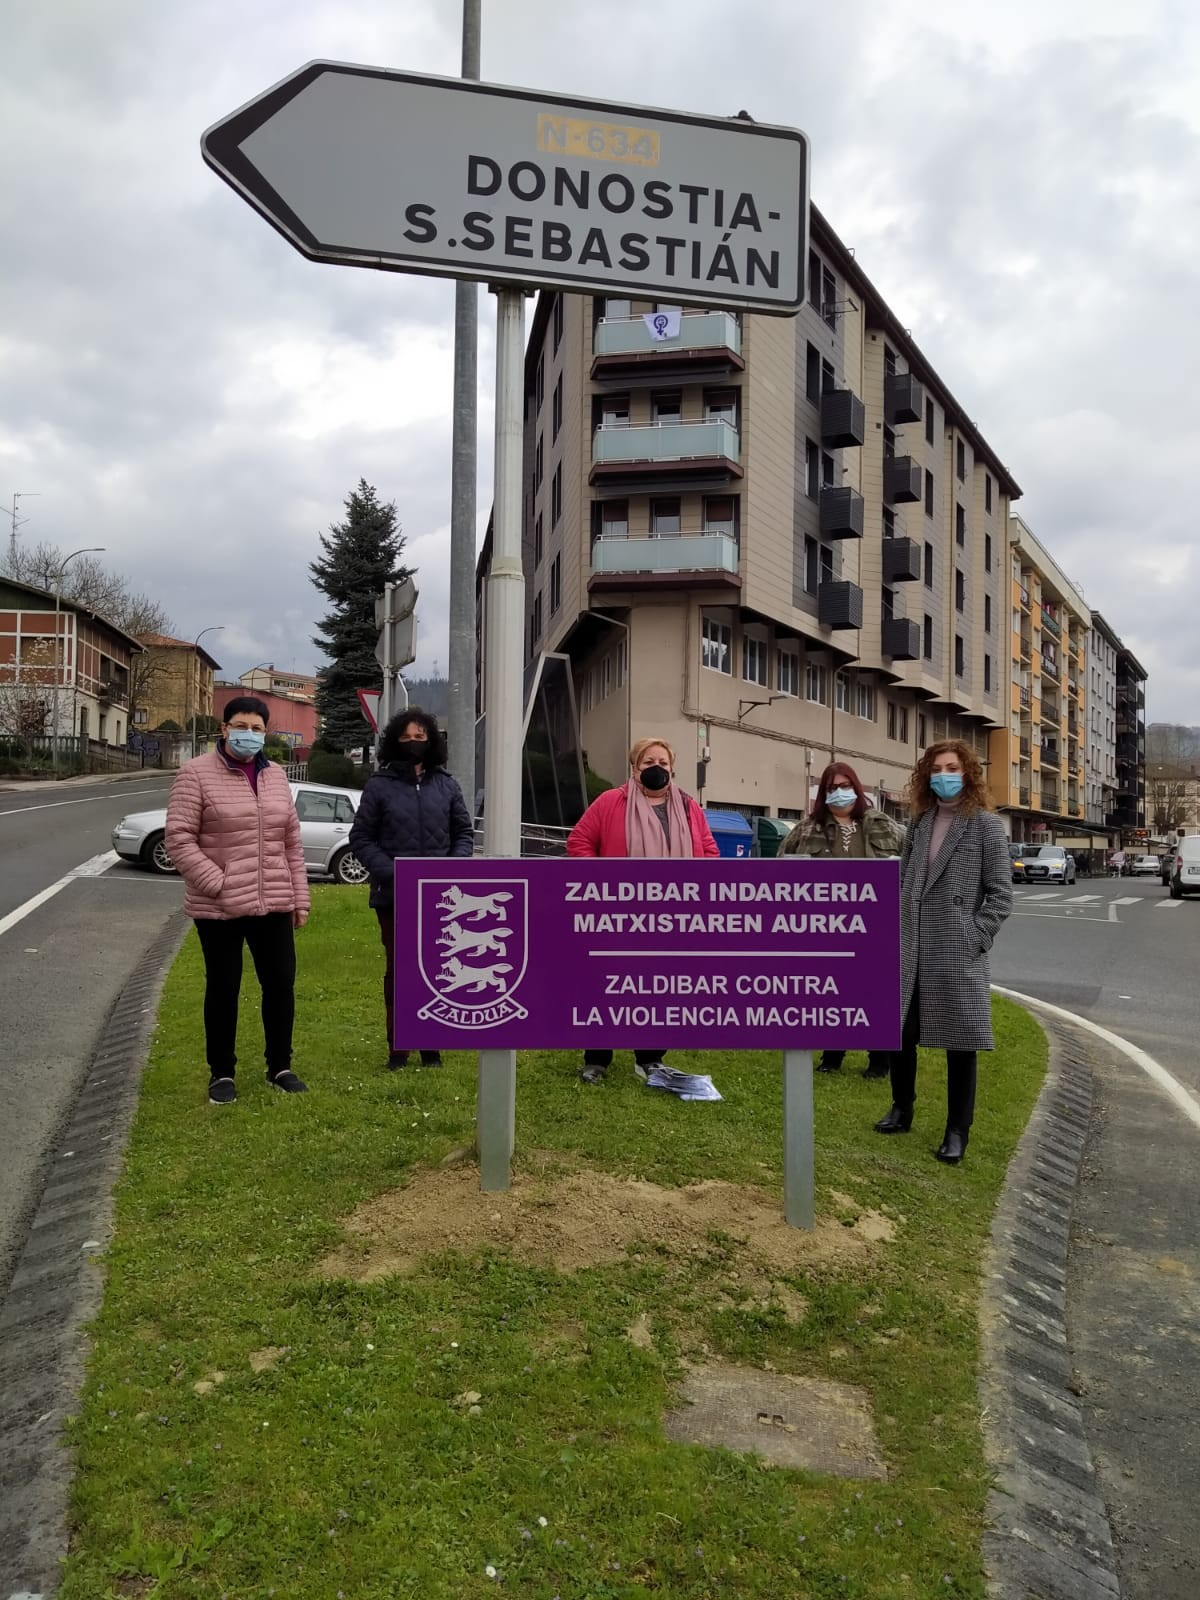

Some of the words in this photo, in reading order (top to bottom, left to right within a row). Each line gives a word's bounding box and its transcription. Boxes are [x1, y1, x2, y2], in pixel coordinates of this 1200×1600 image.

[543, 121, 654, 161] N-634
[467, 154, 781, 233] DONOSTIA-
[402, 203, 780, 289] S.SEBASTIÁN
[564, 882, 701, 902] ZALDIBAR
[709, 882, 878, 902] INDARKERIA
[573, 913, 761, 934] MATXISTAREN
[771, 913, 867, 934] AURKA
[604, 975, 728, 995] ZALDIBAR
[735, 975, 839, 995] CONTRA
[432, 1000, 514, 1025] ZALDUA
[572, 1006, 603, 1026] LA
[608, 1006, 740, 1026] VIOLENCIA
[746, 1006, 870, 1026] MACHISTA
